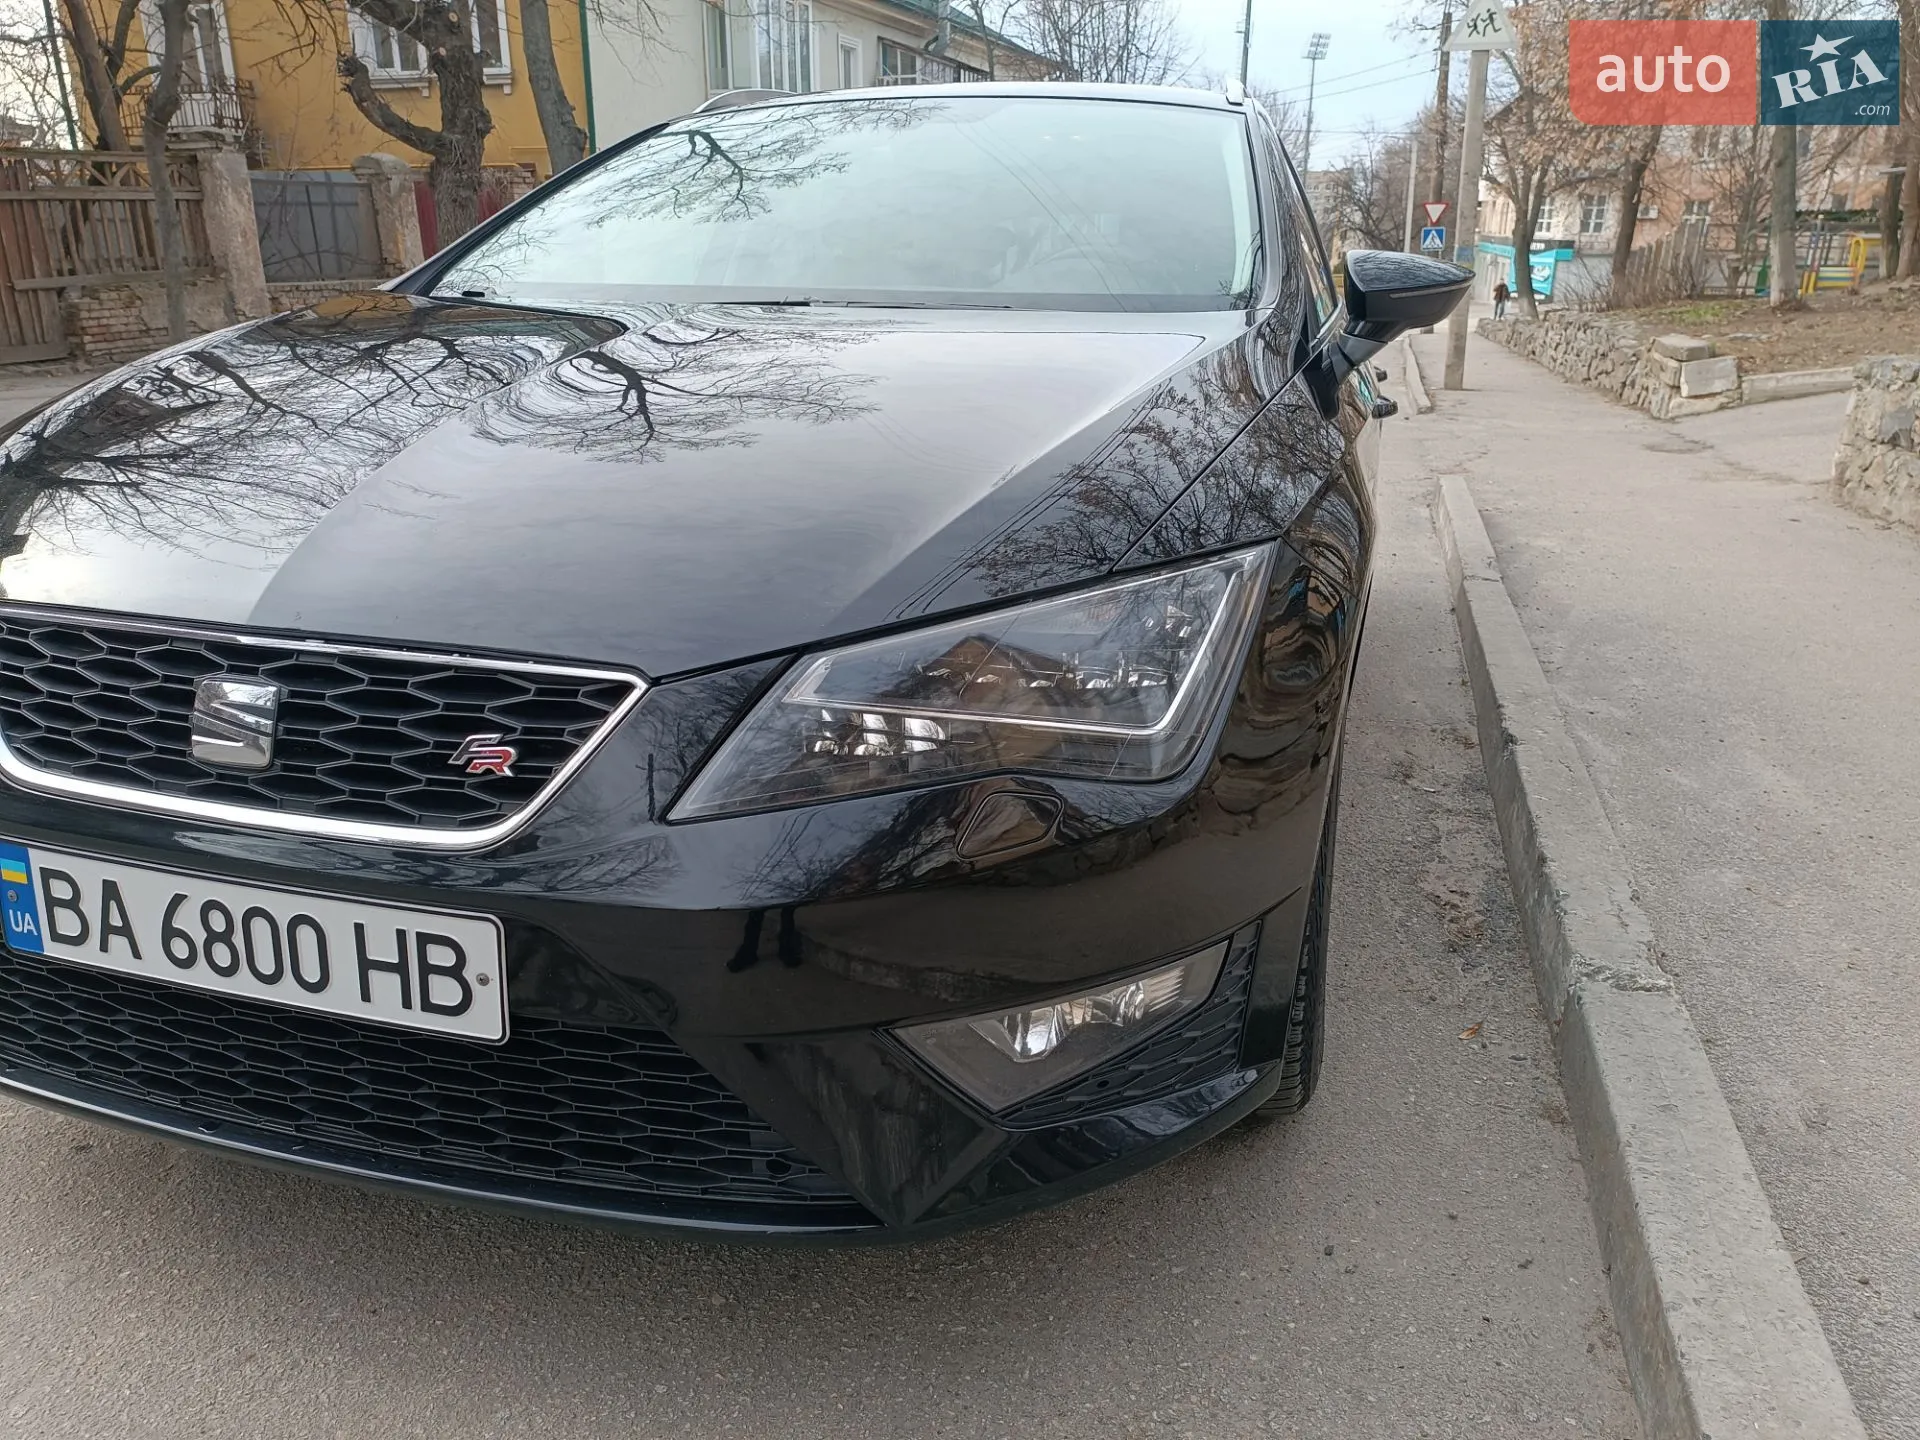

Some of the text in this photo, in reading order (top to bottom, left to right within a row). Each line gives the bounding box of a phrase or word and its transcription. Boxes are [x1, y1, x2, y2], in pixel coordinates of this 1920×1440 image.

[9, 909, 38, 936] UA
[39, 866, 473, 1017] BA 6800 HB
